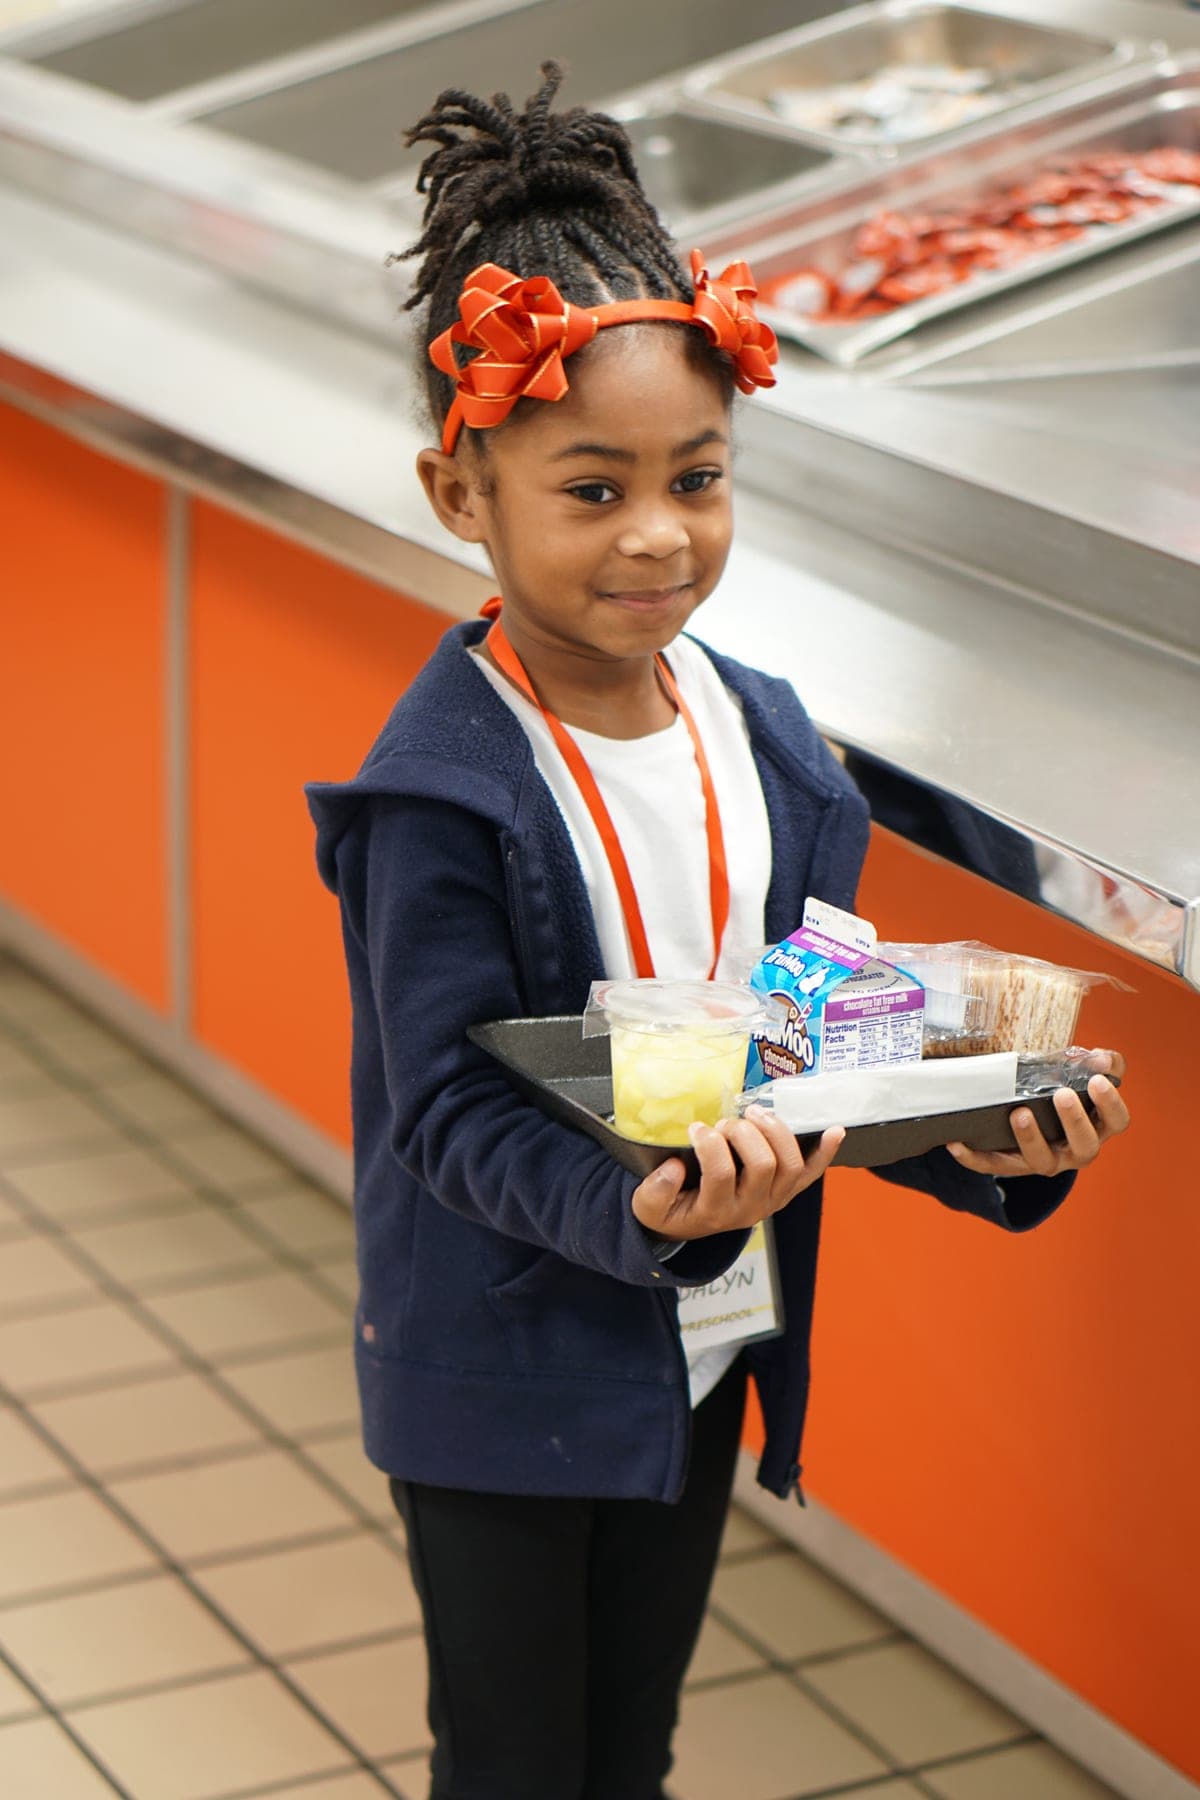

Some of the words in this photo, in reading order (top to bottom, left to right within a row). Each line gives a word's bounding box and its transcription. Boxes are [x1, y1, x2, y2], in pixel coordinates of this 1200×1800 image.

[763, 948, 806, 978] TruMoo
[843, 998, 873, 1012] chocolate
[873, 996, 882, 1007] fat
[882, 994, 895, 1005] free
[895, 992, 908, 1003] milk
[824, 1034, 846, 1044] Facts
[825, 1023, 858, 1035] Nutrition
[764, 1048, 798, 1076] chocolate
